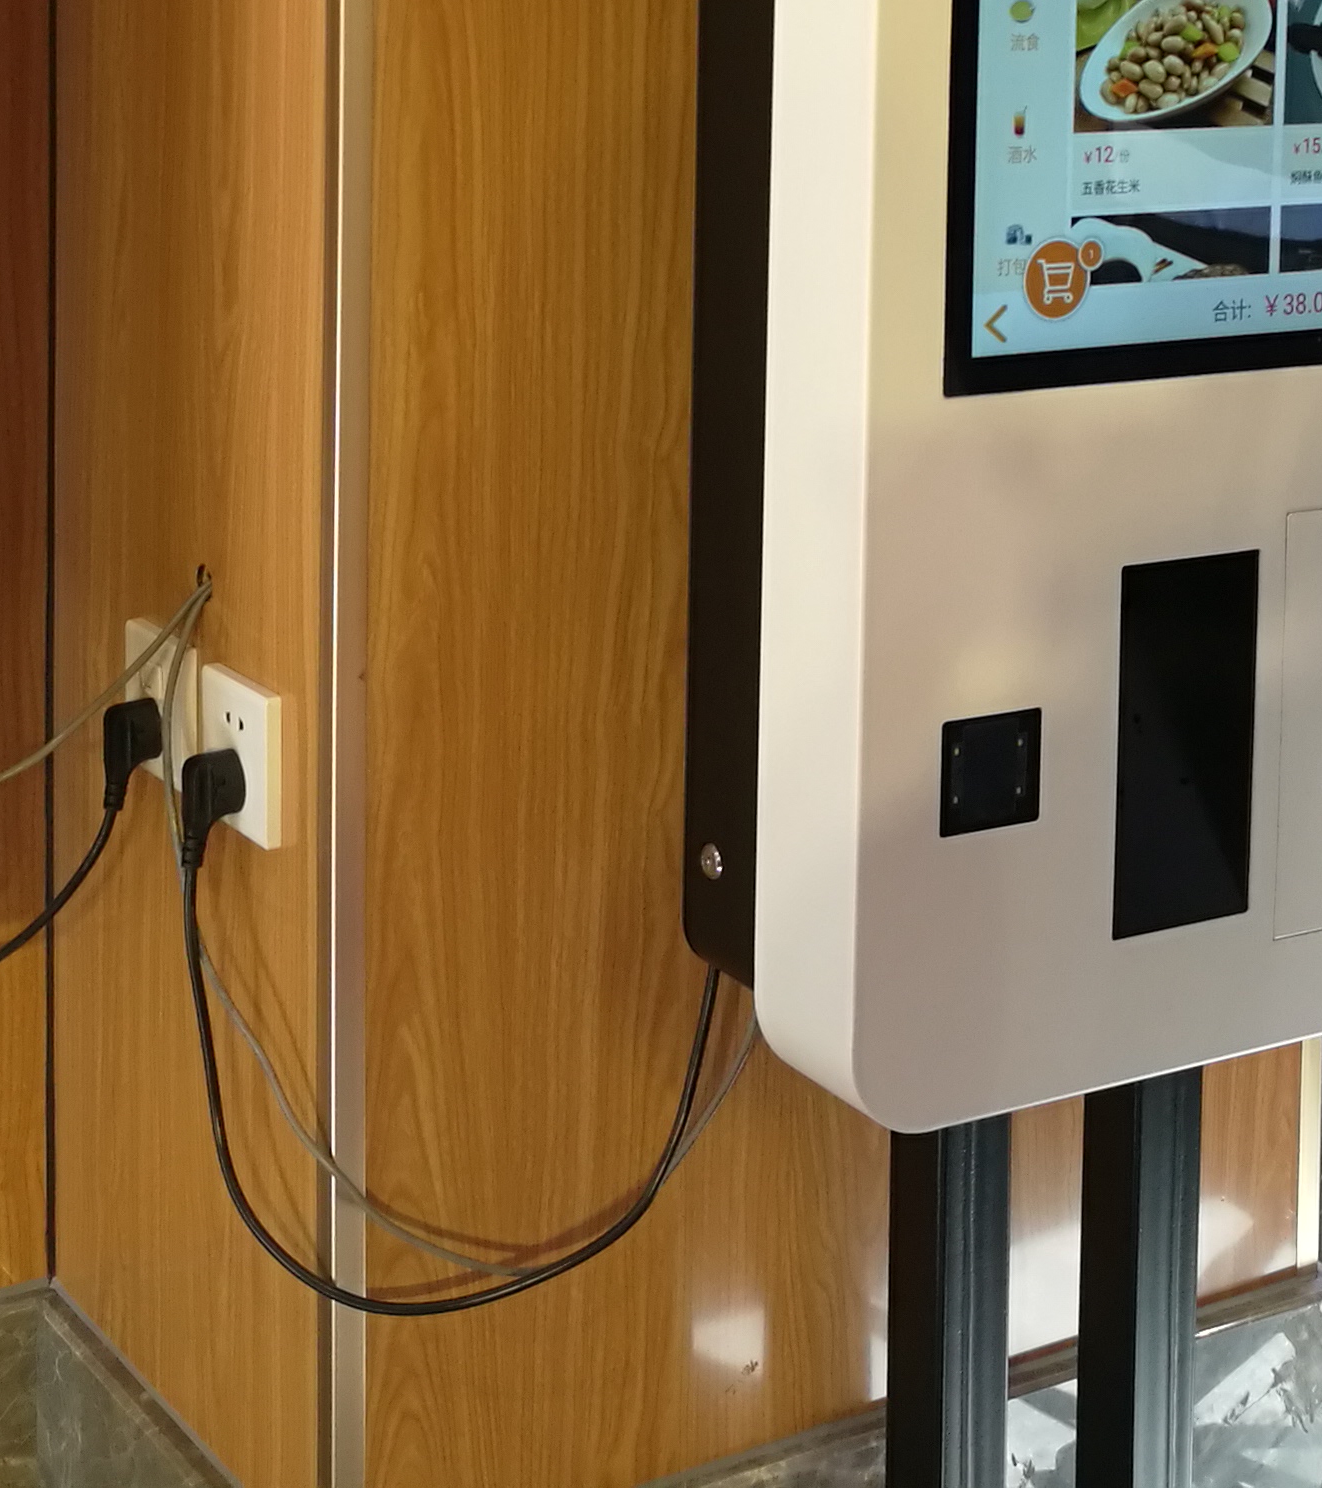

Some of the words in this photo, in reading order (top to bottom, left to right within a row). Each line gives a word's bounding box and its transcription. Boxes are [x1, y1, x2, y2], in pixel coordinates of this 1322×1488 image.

[1007, 144, 1037, 163] 酒水
[1081, 179, 1141, 196] 五香花生米
[997, 258, 1026, 277] 打包
